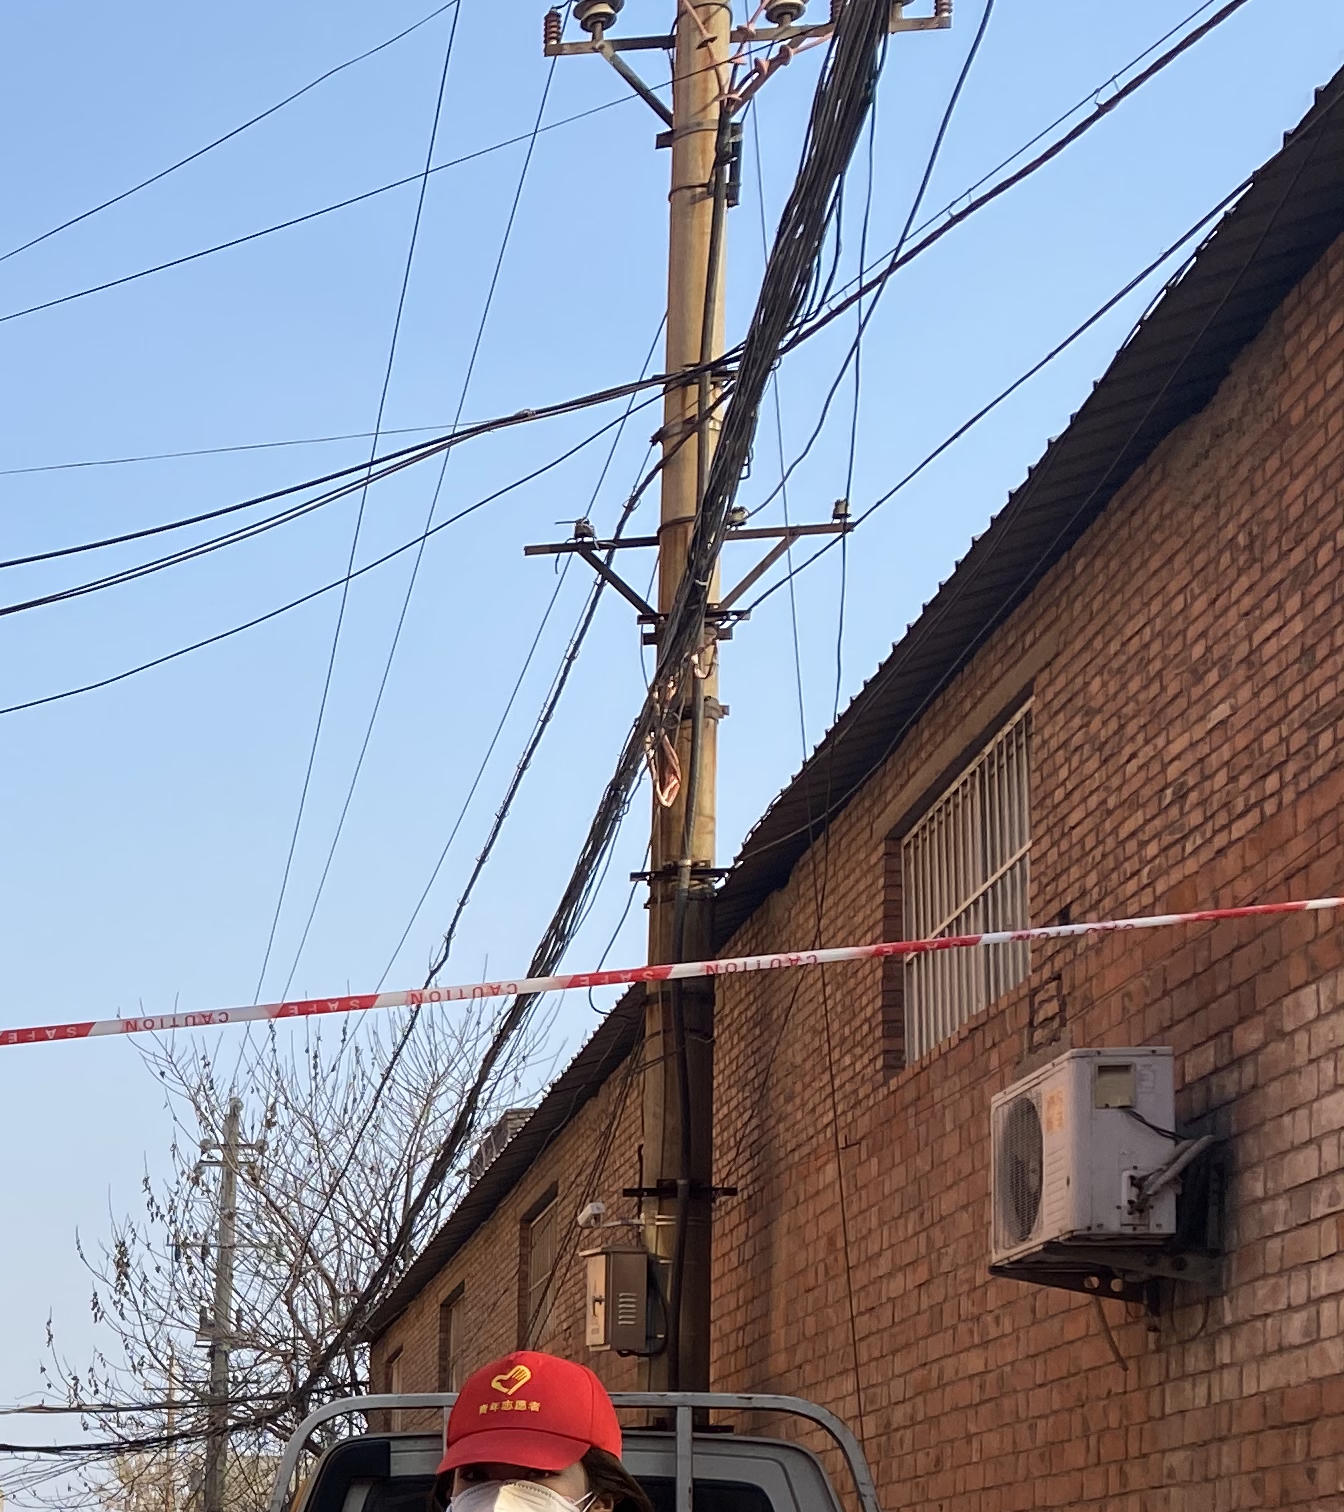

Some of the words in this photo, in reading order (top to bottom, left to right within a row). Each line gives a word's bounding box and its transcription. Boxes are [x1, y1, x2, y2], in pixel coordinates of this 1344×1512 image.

[409, 982, 518, 1005] CAUTION
[288, 998, 361, 1016] SAFE
[124, 1010, 230, 1033] CAUTION
[7, 1025, 78, 1044] SAFE
